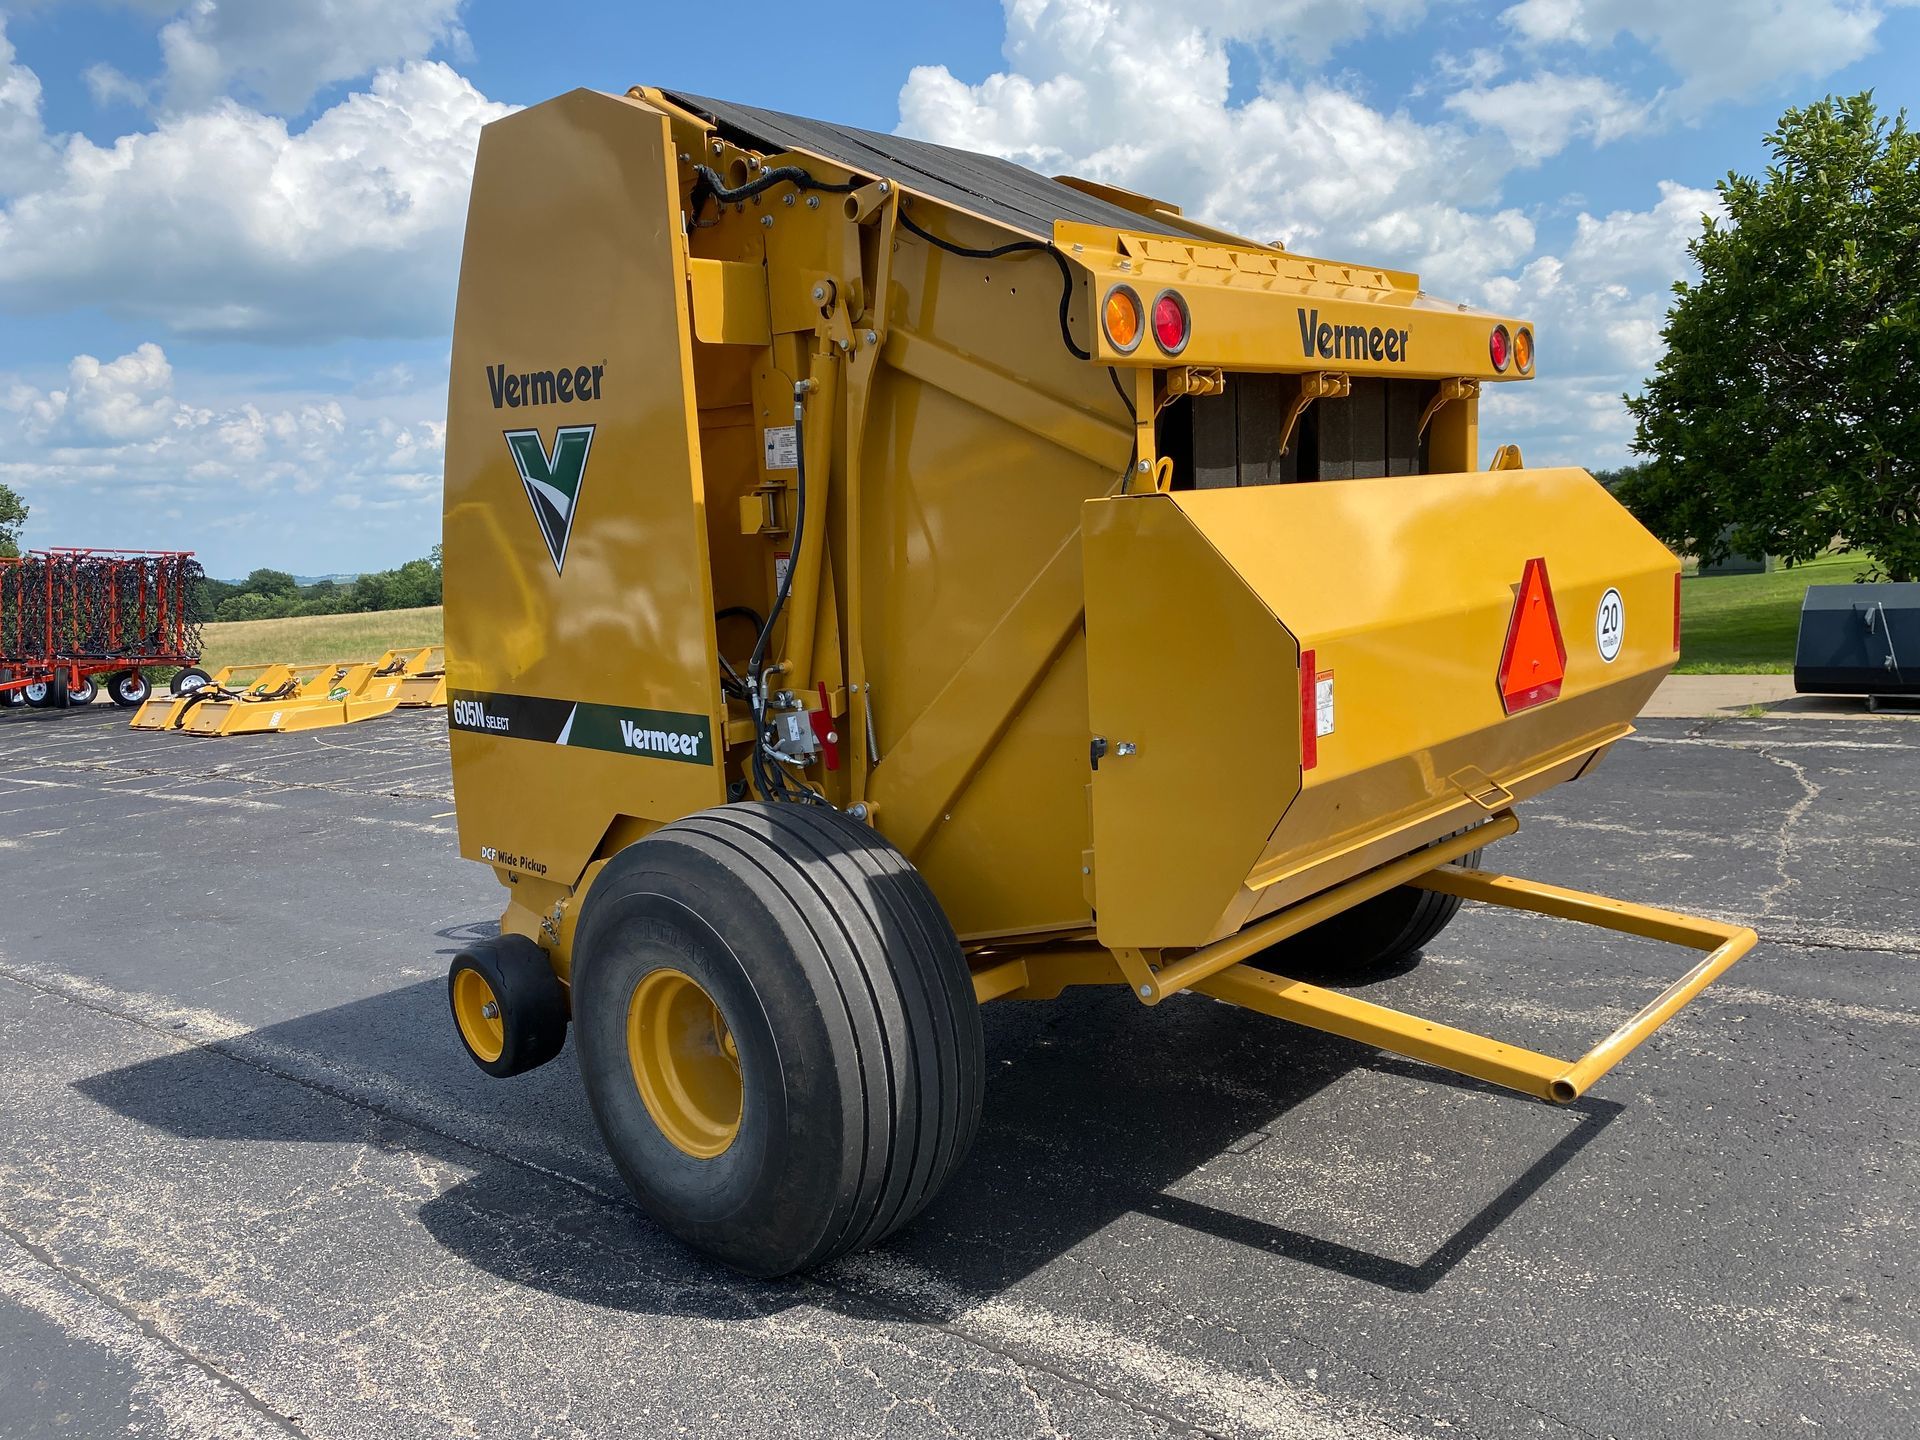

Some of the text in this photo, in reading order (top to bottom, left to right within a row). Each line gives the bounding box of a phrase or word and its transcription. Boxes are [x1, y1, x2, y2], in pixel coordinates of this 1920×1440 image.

[1297, 308, 1409, 362] Vermeer
[486, 363, 604, 409] Vermeer
[1602, 603, 1618, 634] 20
[453, 699, 509, 731] 605N SELECT
[619, 719, 699, 757] Vermeer
[481, 846, 547, 876] DCF Wide Pickup
